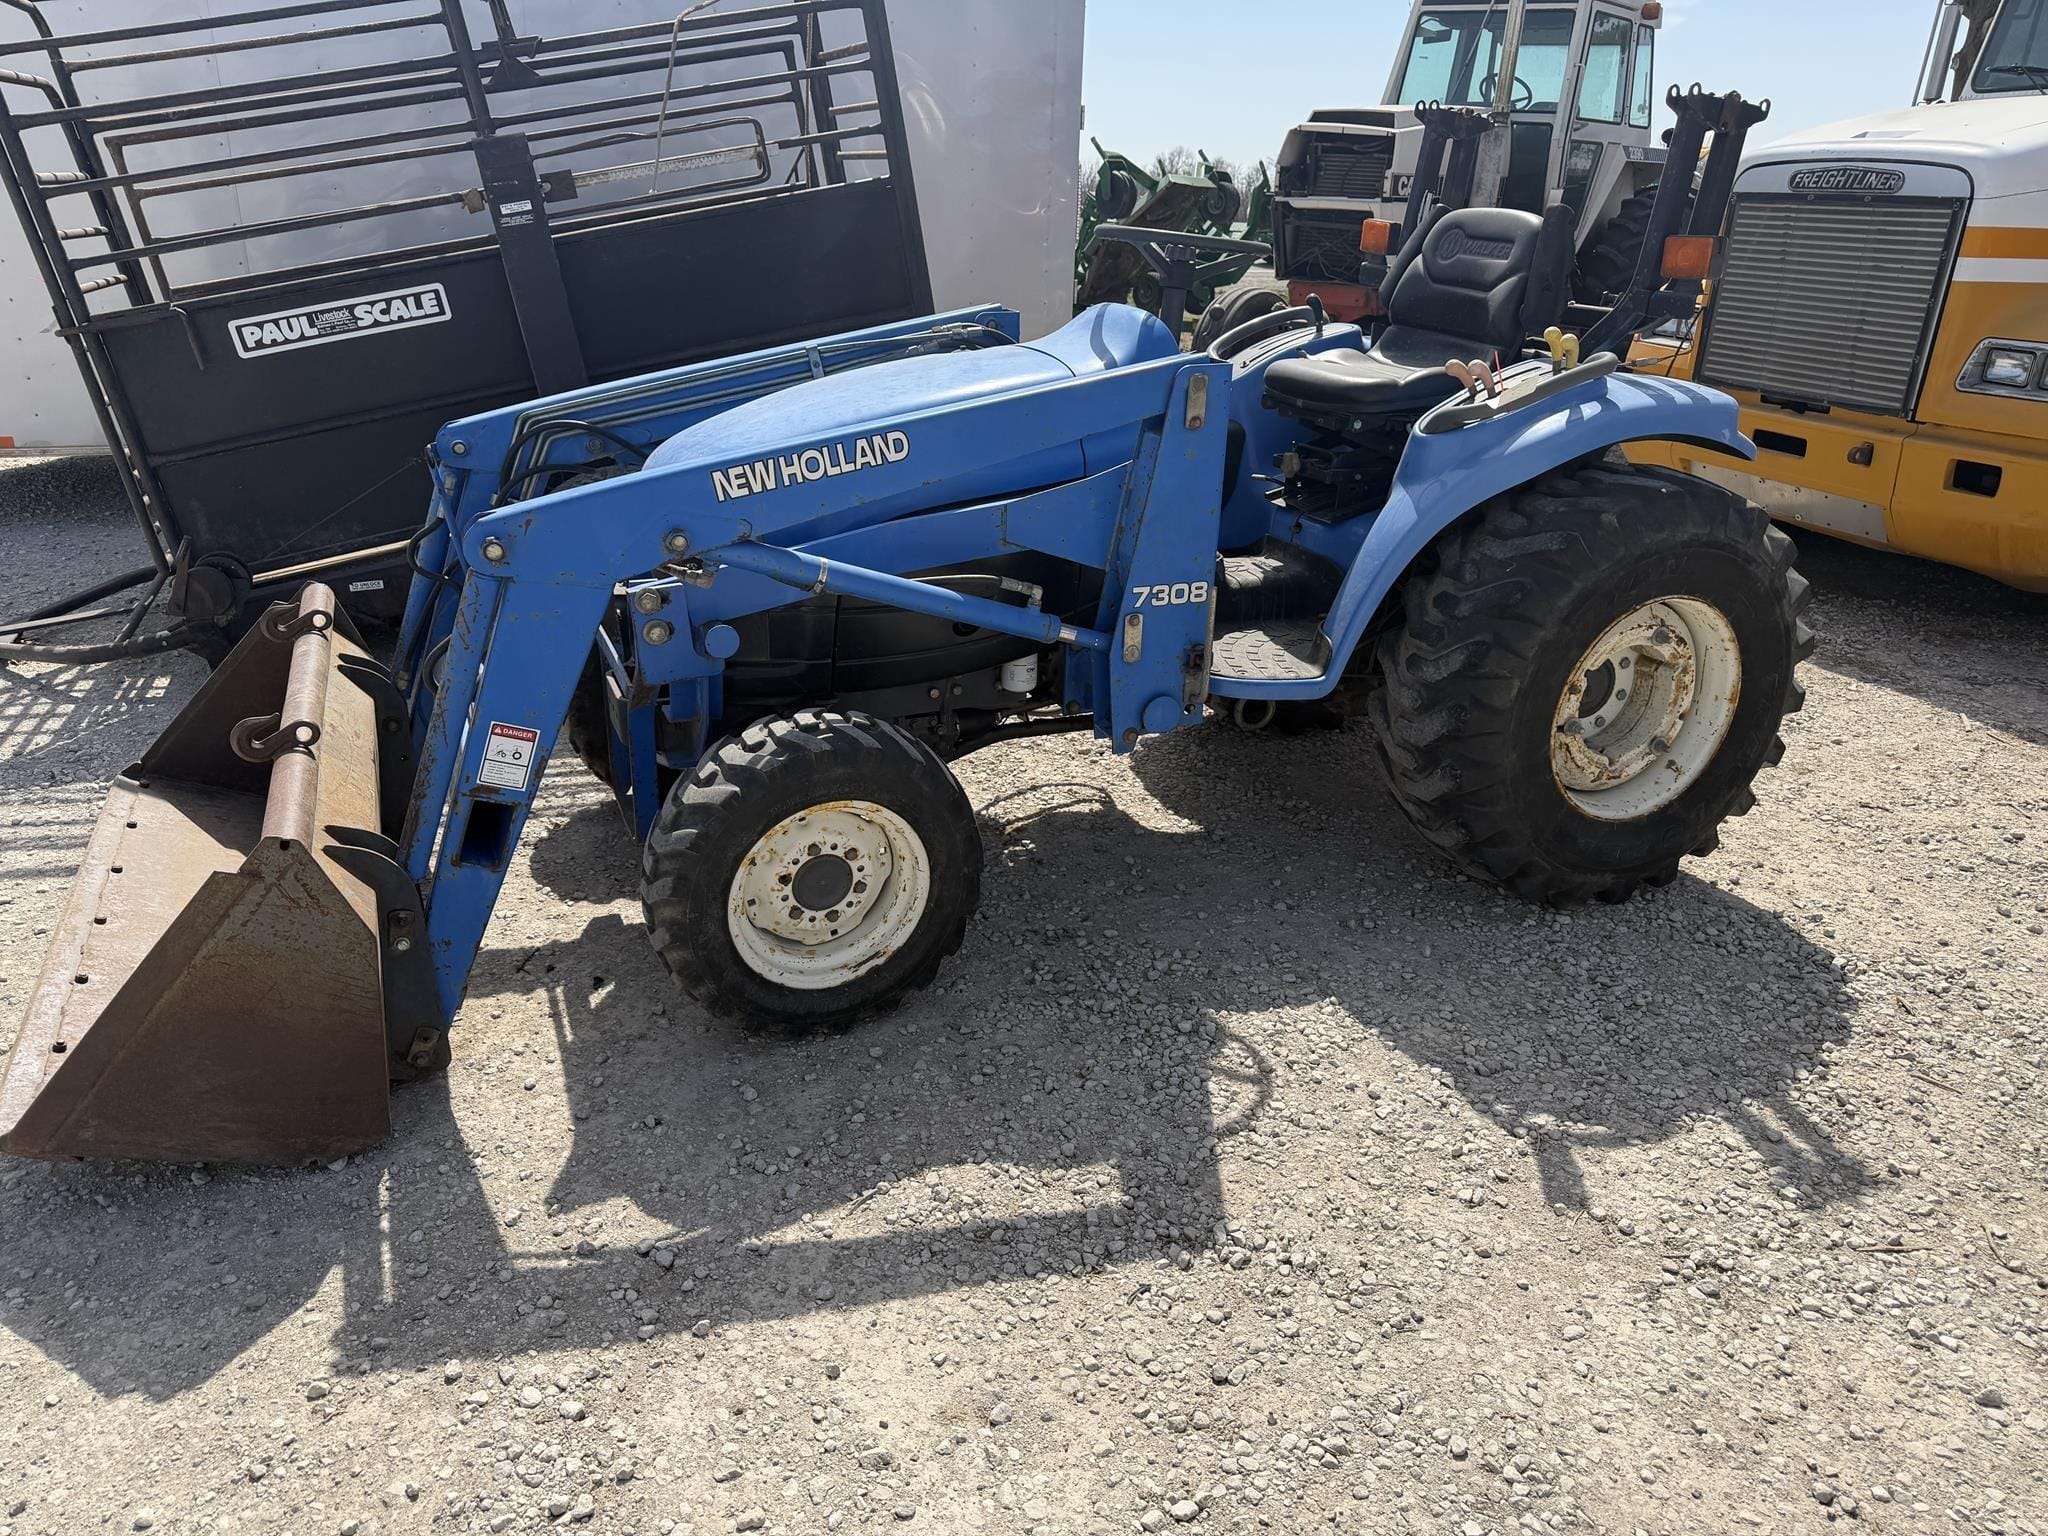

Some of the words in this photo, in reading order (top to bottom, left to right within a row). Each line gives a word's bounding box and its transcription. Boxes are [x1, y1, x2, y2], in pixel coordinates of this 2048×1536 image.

[1398, 175, 1414, 196] CA
[1792, 170, 1897, 188] FREIGHTLINER
[242, 316, 319, 348] PAUL
[313, 308, 351, 323] Livestock
[354, 293, 440, 327] SCALE
[711, 457, 777, 502] NEW
[779, 430, 910, 487] HOLLAND
[1132, 581, 1209, 608] 7308
[503, 728, 533, 739] DANGER
